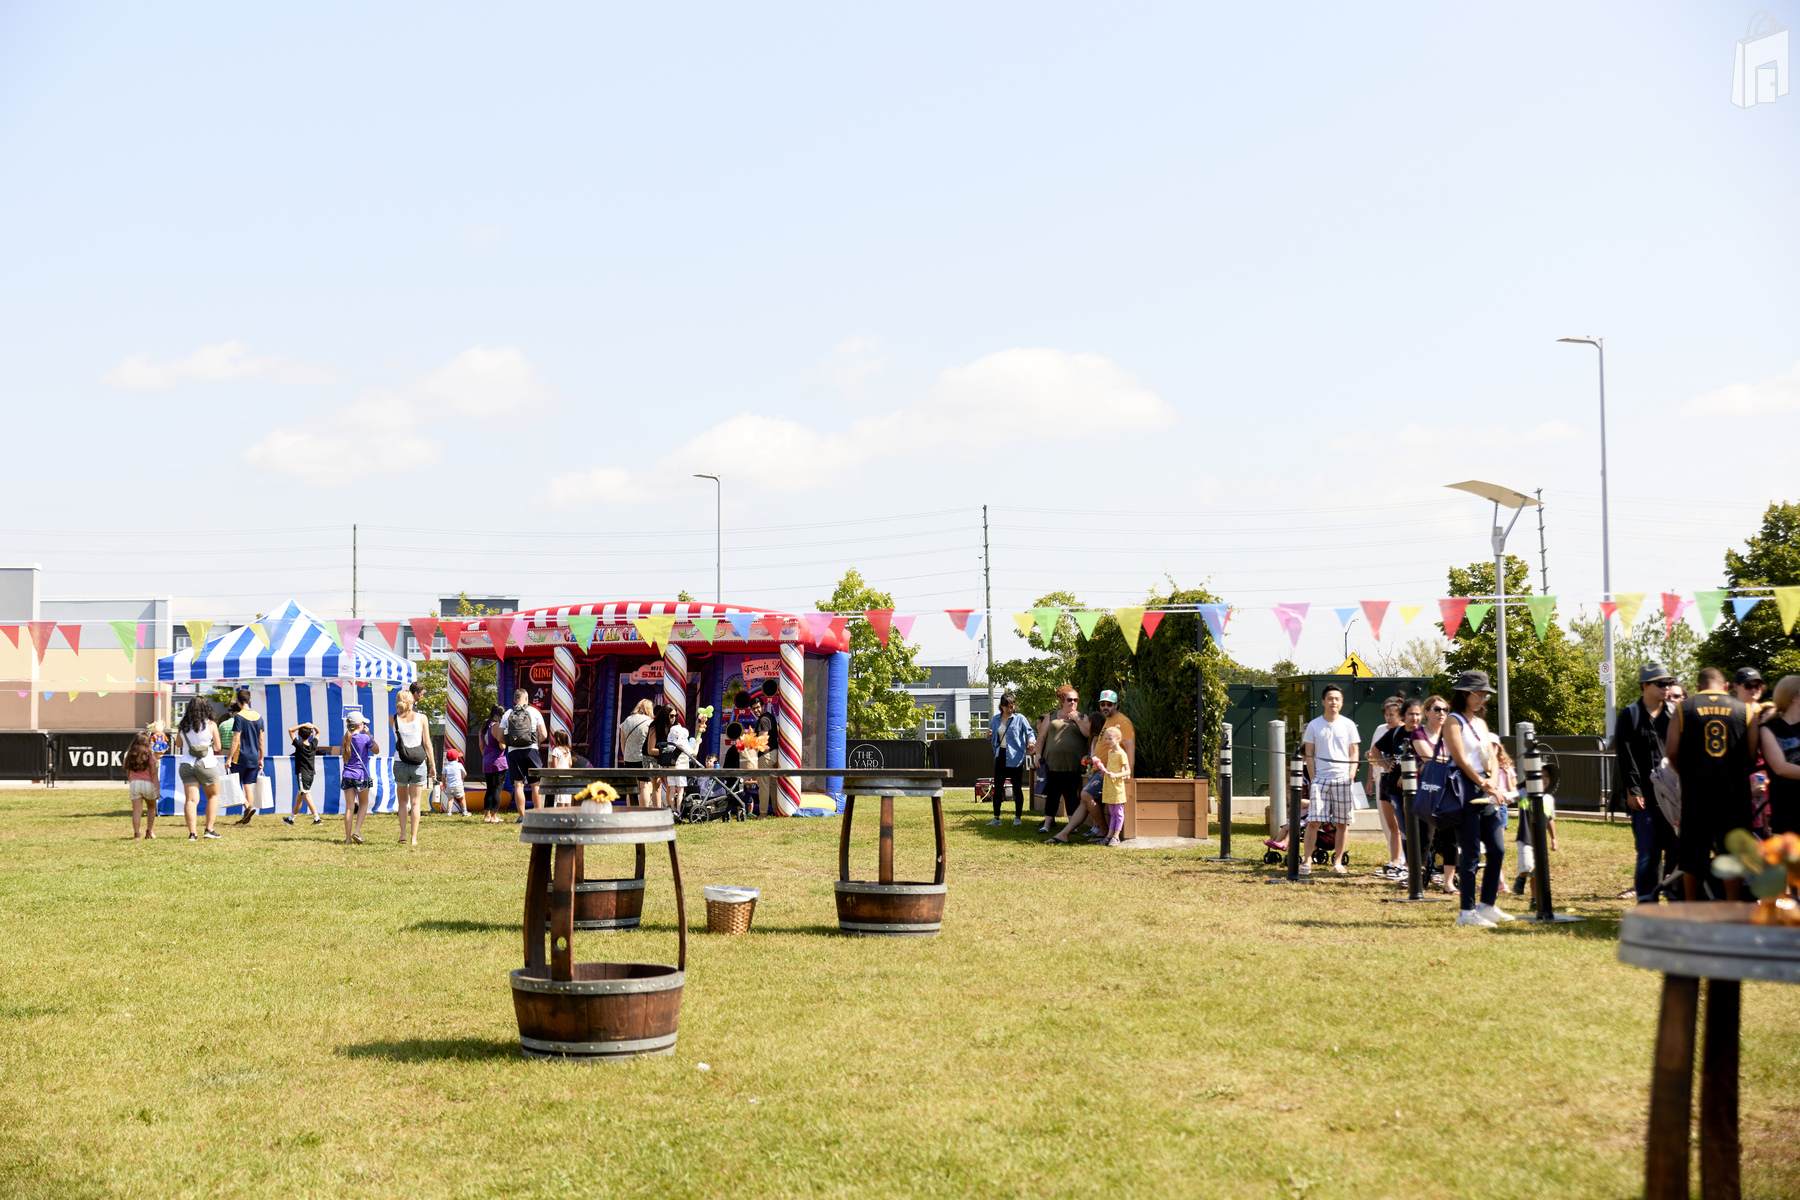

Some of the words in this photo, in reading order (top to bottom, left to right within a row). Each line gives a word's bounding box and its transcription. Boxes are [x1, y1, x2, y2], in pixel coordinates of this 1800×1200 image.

[563, 628, 620, 642] CAIVAL
[533, 667, 551, 678] RING
[1696, 706, 1732, 716] BRYANT
[1704, 720, 1727, 757] 8
[68, 750, 128, 767] VODK
[856, 750, 874, 760] THE
[854, 759, 879, 768] YARD
